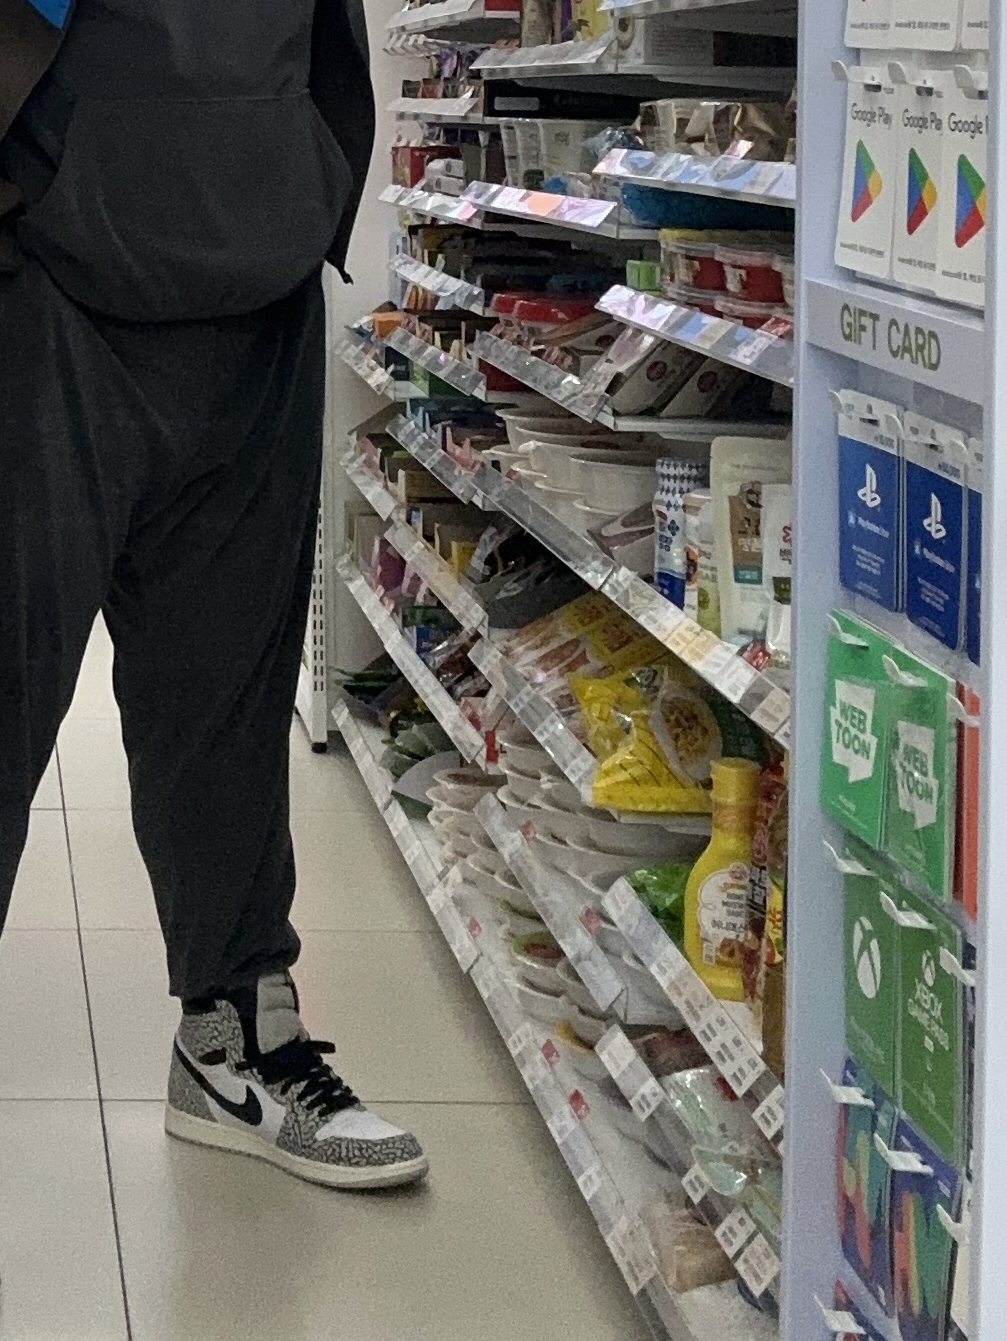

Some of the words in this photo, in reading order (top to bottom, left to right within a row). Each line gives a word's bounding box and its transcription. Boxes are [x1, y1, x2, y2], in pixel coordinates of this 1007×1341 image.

[850, 103, 876, 127] Google
[878, 105, 892, 127] Play
[902, 108, 927, 133] Google
[947, 112, 983, 139] Google
[840, 302, 880, 351] GIFT
[887, 318, 941, 372] CARD
[839, 701, 867, 735] WEB
[834, 720, 871, 760] TOON
[903, 744, 929, 779] WEB
[899, 762, 934, 803] TOON
[914, 978, 944, 1025] XBOX
